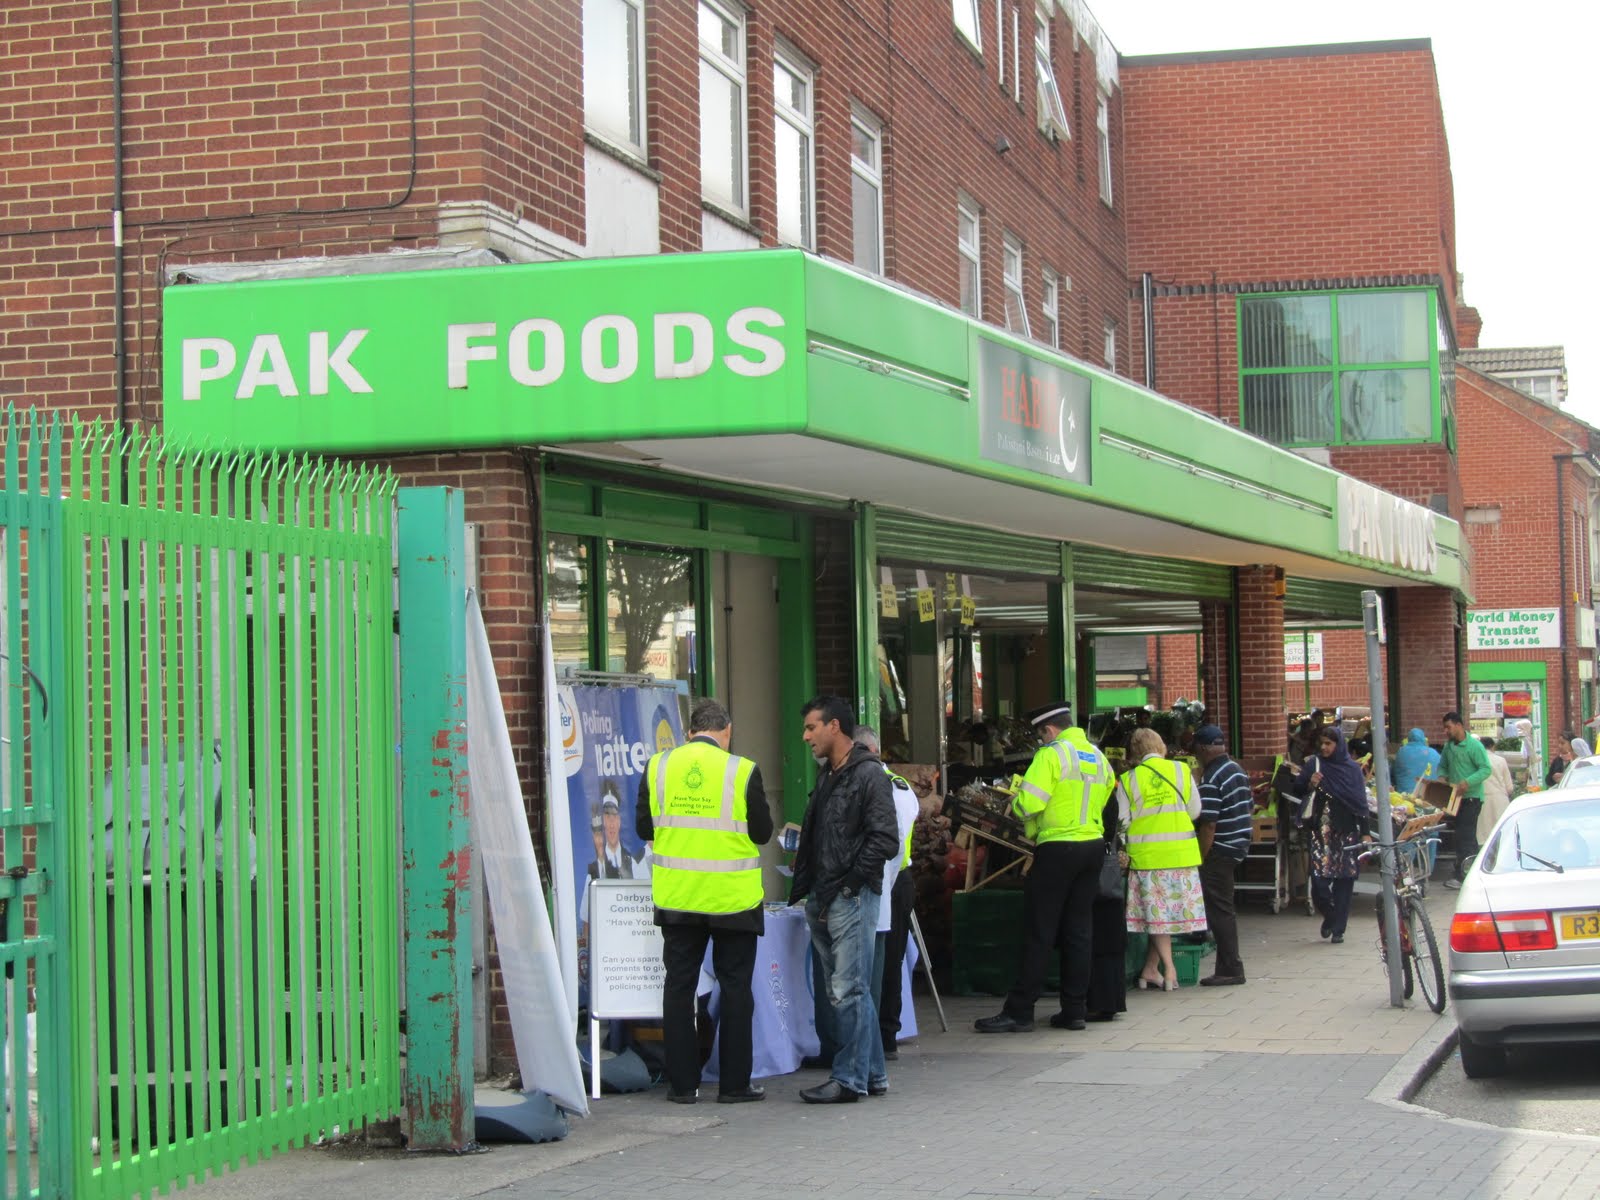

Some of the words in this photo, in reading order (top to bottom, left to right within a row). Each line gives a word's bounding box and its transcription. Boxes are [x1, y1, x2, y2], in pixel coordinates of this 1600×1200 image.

[182, 329, 374, 401] PAK
[447, 307, 786, 390] FOODS
[1466, 612, 1504, 623] World
[1509, 611, 1555, 623] Money
[1478, 625, 1538, 636] Transfer
[1477, 637, 1494, 646] Tel
[1284, 647, 1320, 655] USTOER
[637, 956, 659, 964] spare
[653, 964, 665, 973] giv
[609, 983, 641, 991] policing
